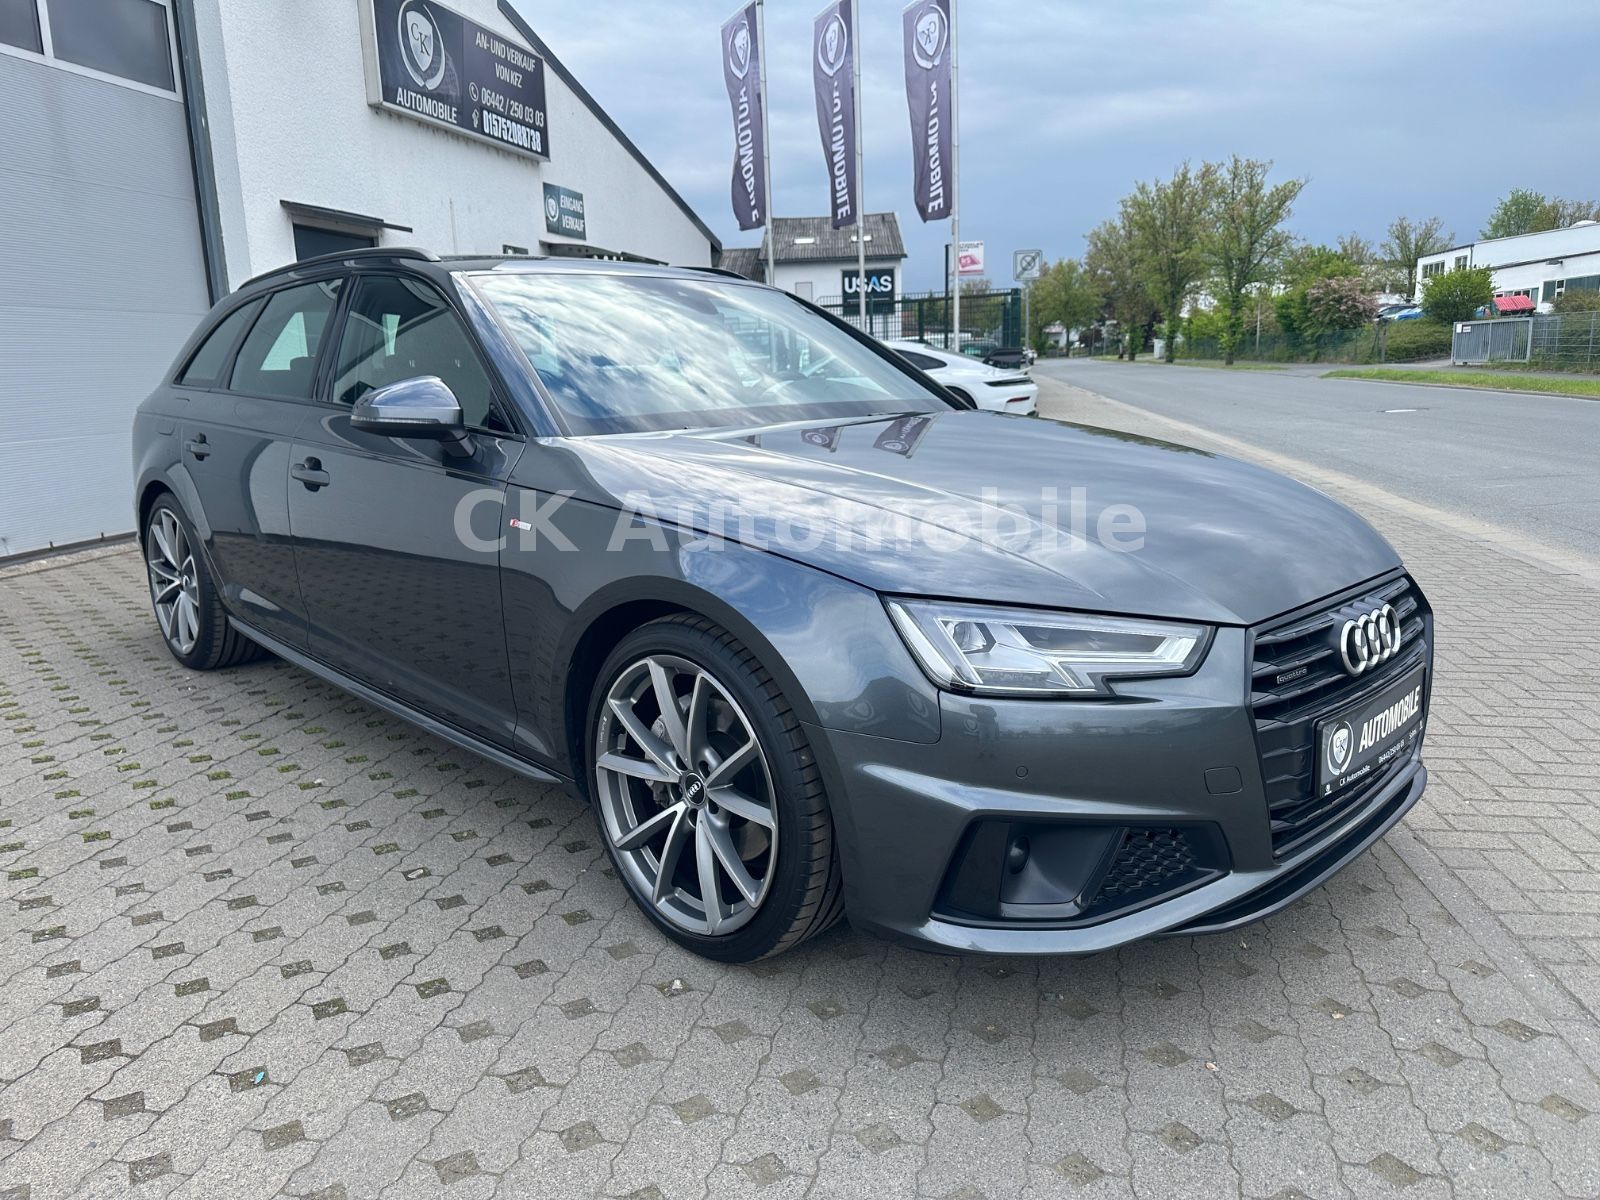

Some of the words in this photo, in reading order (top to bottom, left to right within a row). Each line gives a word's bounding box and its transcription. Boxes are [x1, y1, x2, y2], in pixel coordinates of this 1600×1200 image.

[411, 22, 430, 56] CK
[475, 31, 490, 50] AN-
[490, 38, 506, 59] UND
[506, 46, 536, 72] VERKAUF
[495, 62, 510, 83] VON
[510, 71, 523, 88] KFZ
[396, 87, 458, 123] AUTOMOBILE
[481, 87, 504, 112] 06442
[504, 98, 510, 115] /
[510, 100, 524, 120] 250
[524, 105, 534, 124] 03
[534, 110, 545, 128] 03
[560, 194, 583, 214] EINGANG
[562, 213, 584, 232] VERKAUF
[844, 275, 893, 293] USAS
[1280, 668, 1307, 683] quattro
[1358, 685, 1421, 753] AUTOMOBILE
[1346, 764, 1371, 783] Automobile
